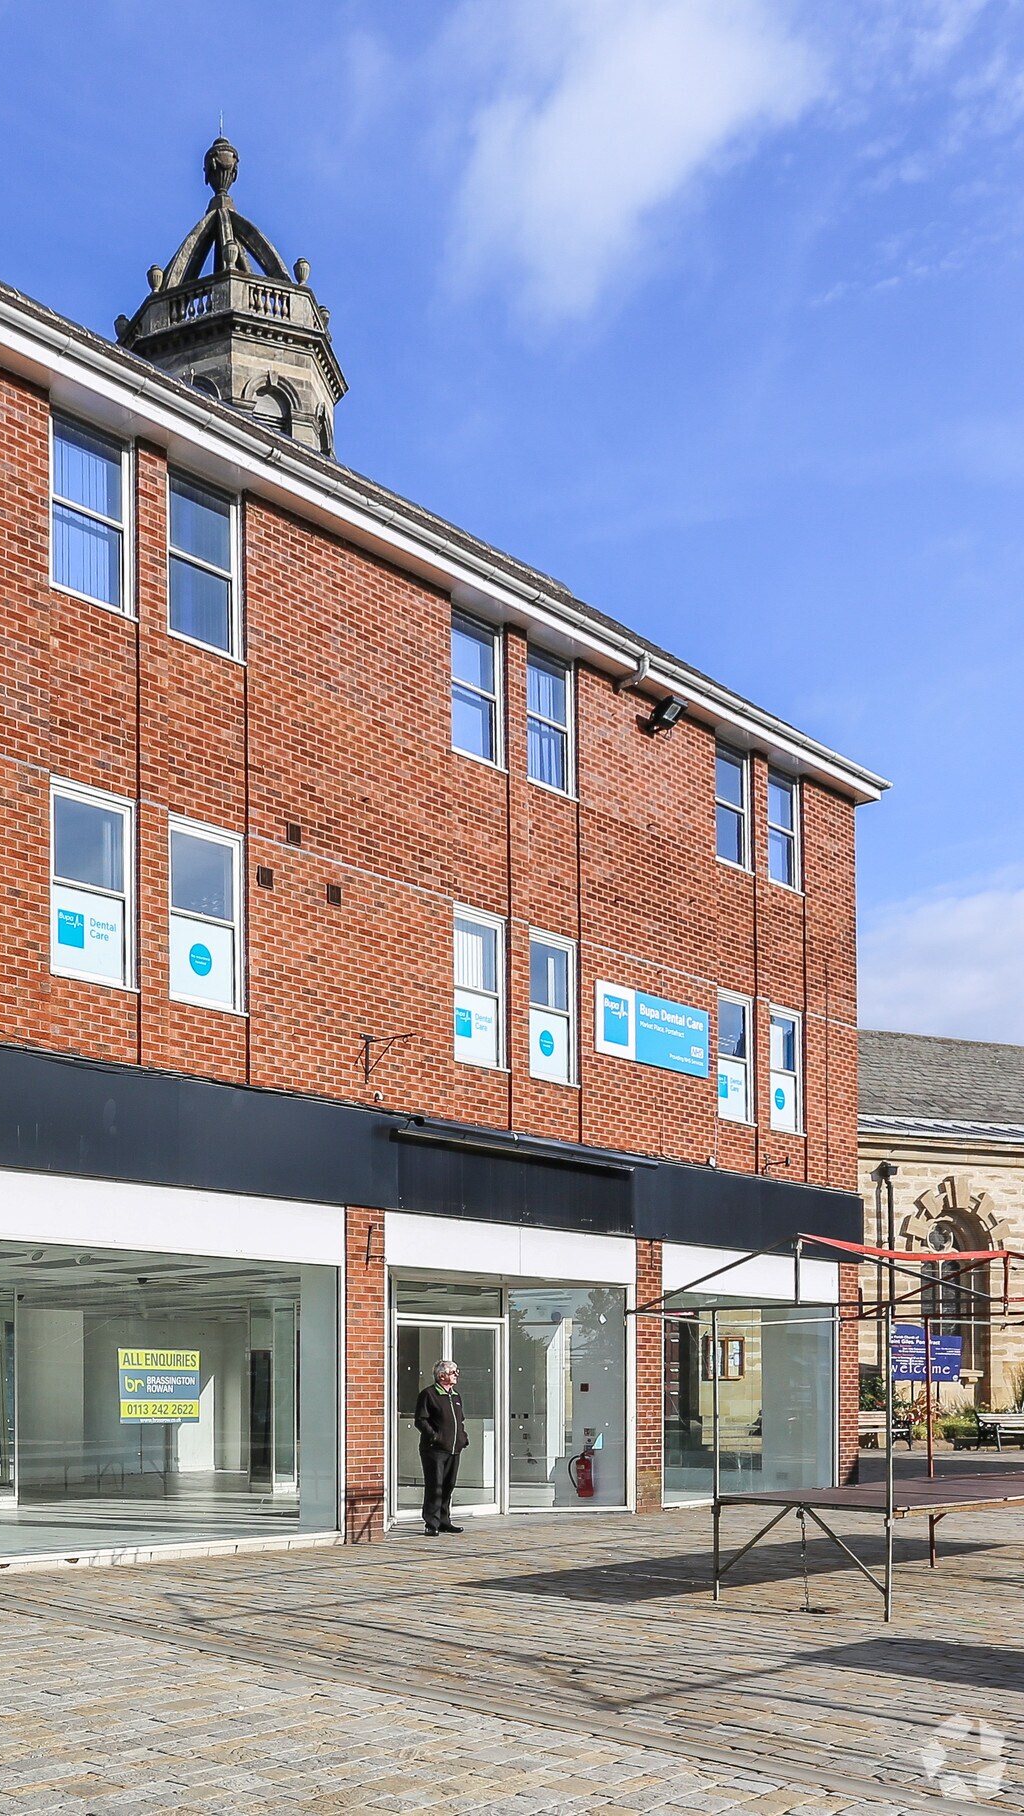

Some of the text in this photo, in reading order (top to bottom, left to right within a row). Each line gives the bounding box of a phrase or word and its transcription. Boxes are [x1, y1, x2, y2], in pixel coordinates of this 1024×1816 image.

[58, 911, 75, 922] Bupa
[89, 917, 117, 932] Dental
[89, 929, 109, 942] Care
[604, 998, 620, 1010] Bupa
[475, 1013, 492, 1024] Dental
[639, 1003, 704, 1032] Bupa Dental Care
[475, 1022, 488, 1031] Care
[639, 1020, 653, 1030] Market
[691, 1048, 703, 1058] NHS
[123, 1352, 197, 1367] ALL ENQUIRIES
[125, 1375, 195, 1393] br BRASSINGTON
[146, 1385, 174, 1393] ROWAN
[127, 1404, 194, 1415] 0113 242 2622
